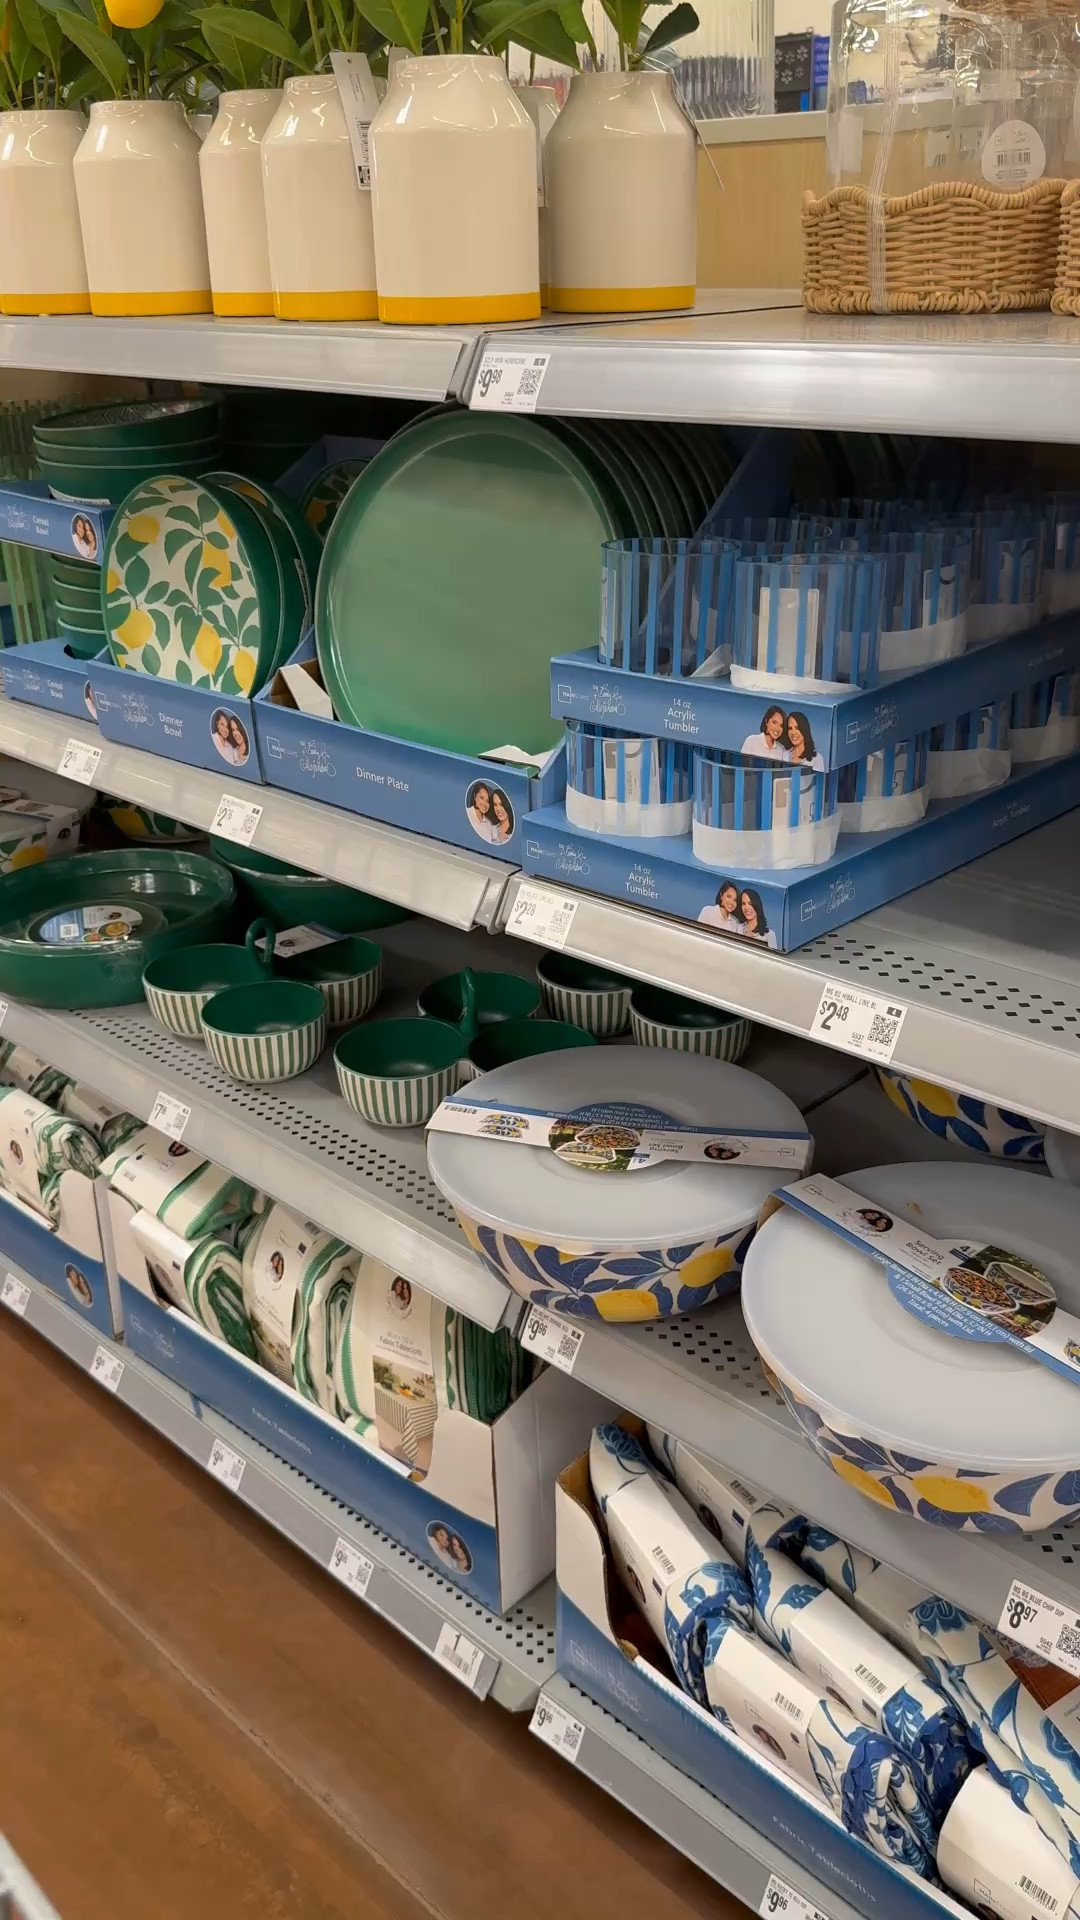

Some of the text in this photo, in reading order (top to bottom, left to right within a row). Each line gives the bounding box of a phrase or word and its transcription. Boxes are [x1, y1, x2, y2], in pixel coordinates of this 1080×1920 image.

[673, 698, 681, 707] 14
[158, 712, 183, 727] Dinner
[667, 707, 696, 721] Acrylic
[163, 724, 183, 739] Bowl
[663, 719, 700, 734] Tumbler
[356, 767, 410, 792] Dinner Plate
[634, 863, 641, 872] 14
[628, 872, 656, 887] Acrylic
[625, 882, 659, 899] Tumbler
[842, 993, 858, 1004] HIBALL
[858, 999, 870, 1008] LINE
[905, 1242, 929, 1257] Bowl
[926, 1254, 943, 1266] Set
[914, 1240, 945, 1262] Serving
[872, 1253, 893, 1266] Large
[889, 1263, 907, 1274] Bowl
[917, 1281, 930, 1289] Dia
[932, 1290, 944, 1298] 4.4
[953, 1303, 973, 1316] (27.9
[968, 1313, 982, 1322] cm
[994, 1328, 1010, 1338] cm)
[1007, 1335, 1026, 1347] with
[1022, 1345, 1035, 1353] lid
[895, 1283, 914, 1295] (24.9
[910, 1293, 922, 1301] cm
[924, 1302, 938, 1310] 9.4
[934, 1308, 950, 1318] cm)
[946, 1315, 965, 1327] with
[902, 1279, 922, 1292] Small
[918, 1290, 937, 1302] Bowl
[934, 1299, 947, 1308] 9.8
[951, 1310, 965, 1319] Dia
[965, 1319, 979, 1327] 3.7
[906, 1298, 927, 1311] Total:
[927, 1312, 951, 1327] pieces
[1013, 1585, 1021, 1594] MS
[1022, 1590, 1029, 1599] BG
[1029, 1594, 1042, 1606] BLUE
[1042, 1601, 1055, 1612] CHIP
[1055, 1608, 1064, 1617] DIP
[772, 1816, 876, 1902] Fabric Tablecloths
